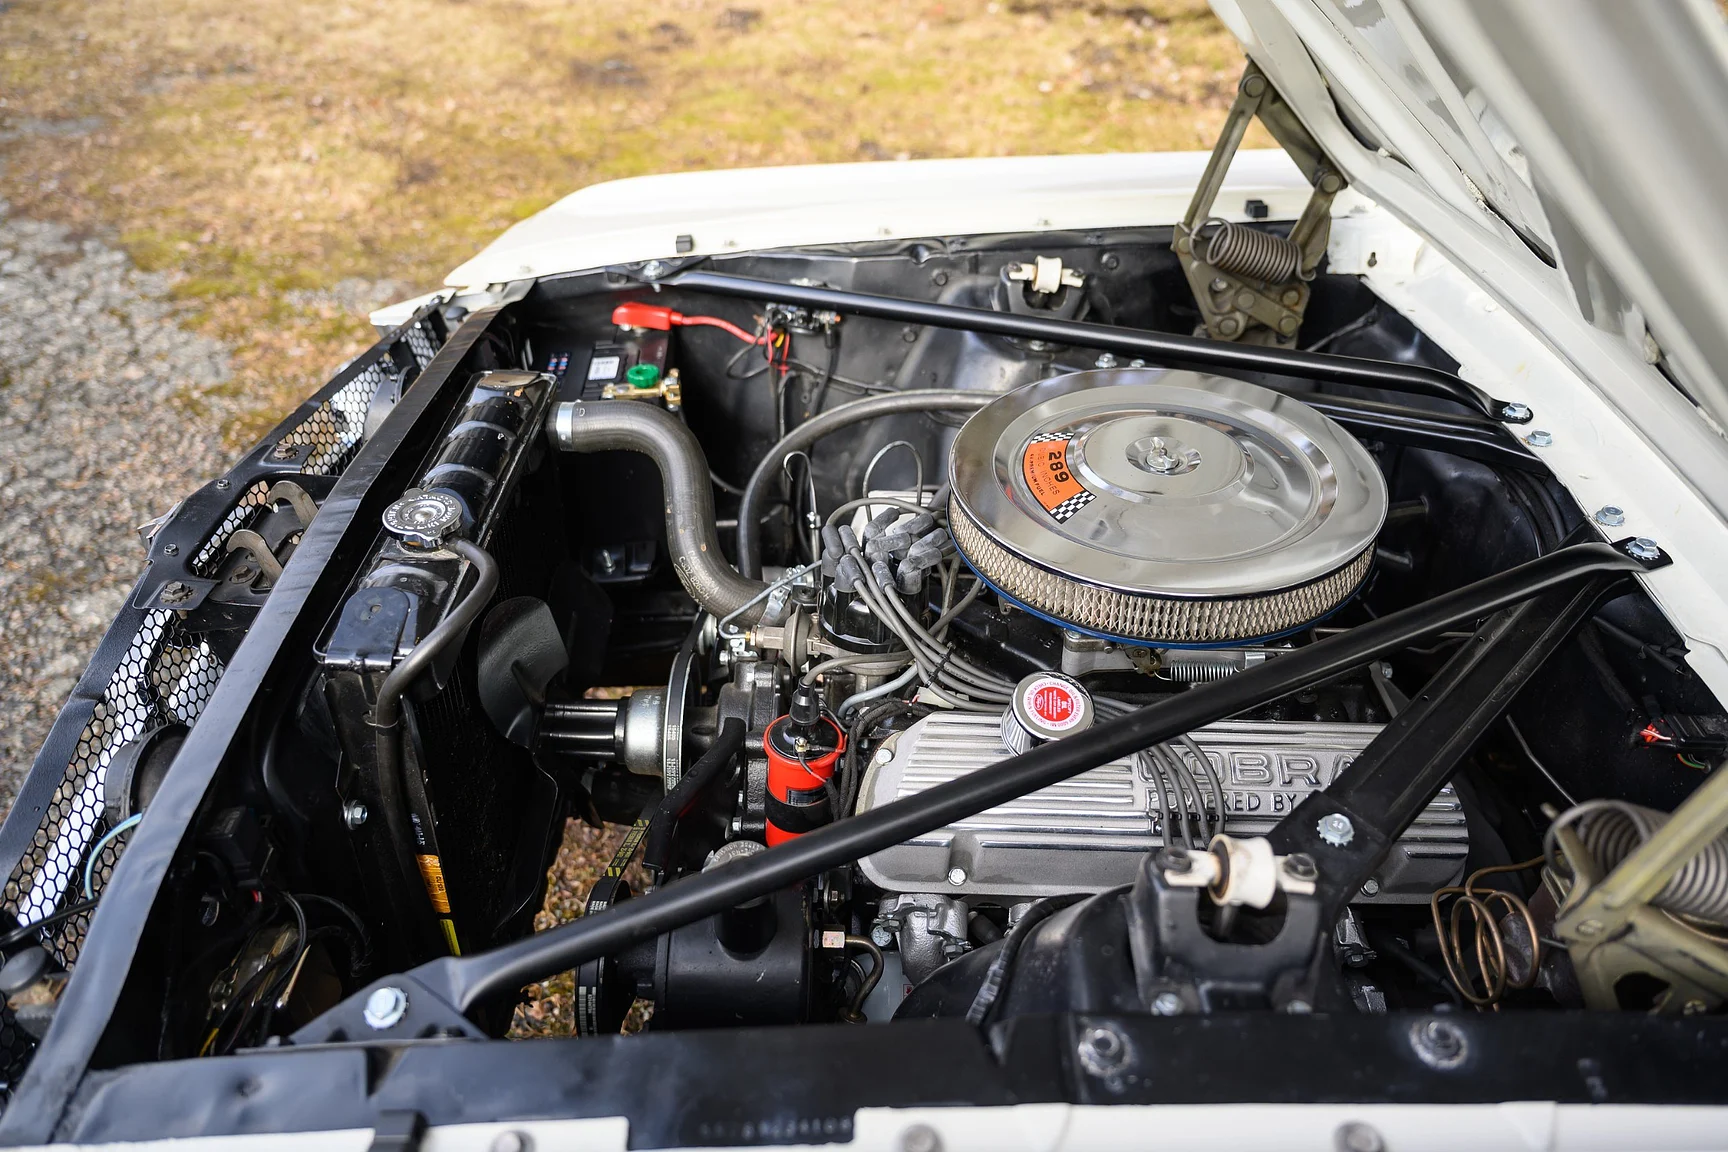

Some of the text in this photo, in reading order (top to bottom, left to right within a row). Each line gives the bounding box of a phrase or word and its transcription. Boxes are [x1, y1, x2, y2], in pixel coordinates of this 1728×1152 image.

[1049, 451, 1069, 483] 289
[1041, 470, 1060, 496] INCHES
[1271, 793, 1297, 812] BY
